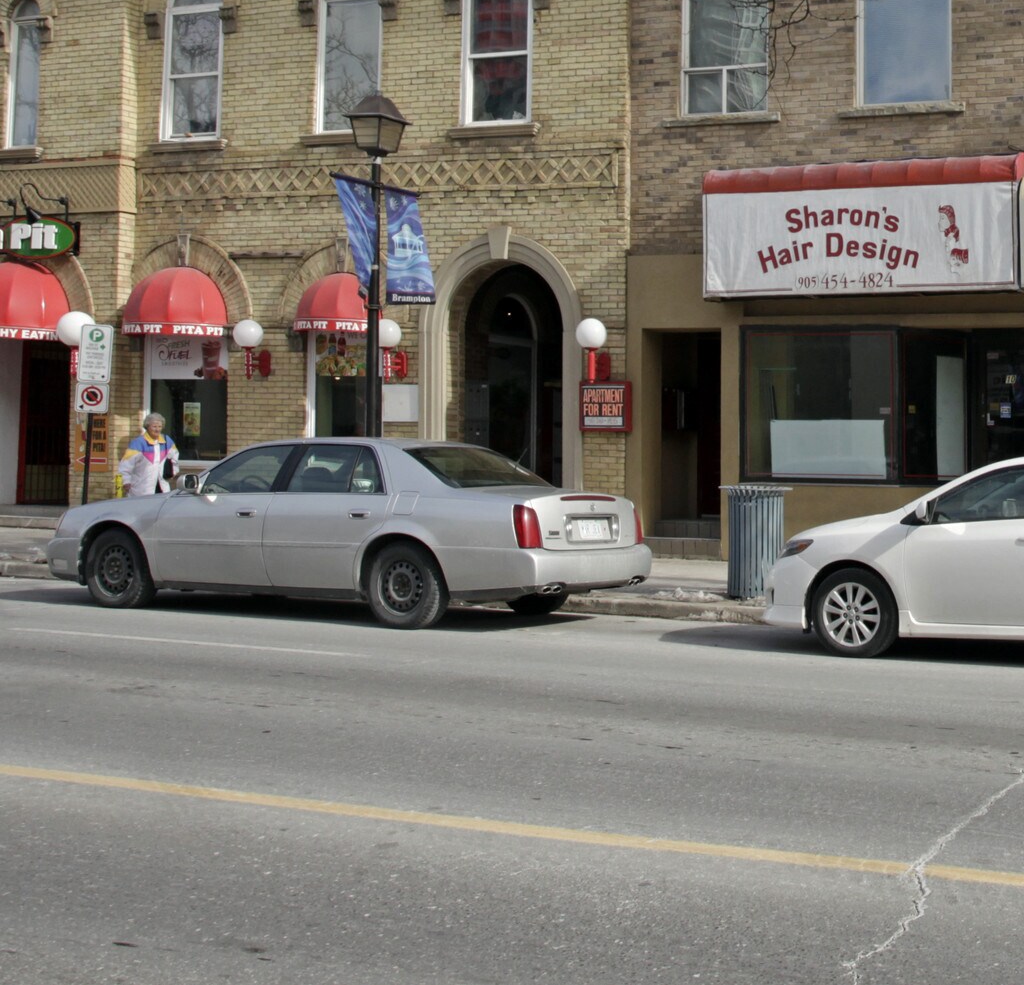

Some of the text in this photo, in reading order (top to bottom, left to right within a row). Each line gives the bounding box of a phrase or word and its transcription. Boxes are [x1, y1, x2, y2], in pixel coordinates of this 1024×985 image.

[785, 205, 900, 233] Sharon's
[10, 223, 58, 249] Pit
[757, 232, 919, 274] Hair Design
[392, 293, 431, 304] Brampton
[143, 324, 162, 333] PIT
[173, 325, 204, 335] PITA
[313, 320, 328, 329] PIT
[336, 321, 359, 331] PITA
[21, 329, 60, 341] EATIN
[583, 388, 624, 403] APARTMENT
[583, 403, 624, 416] FOR RENT
